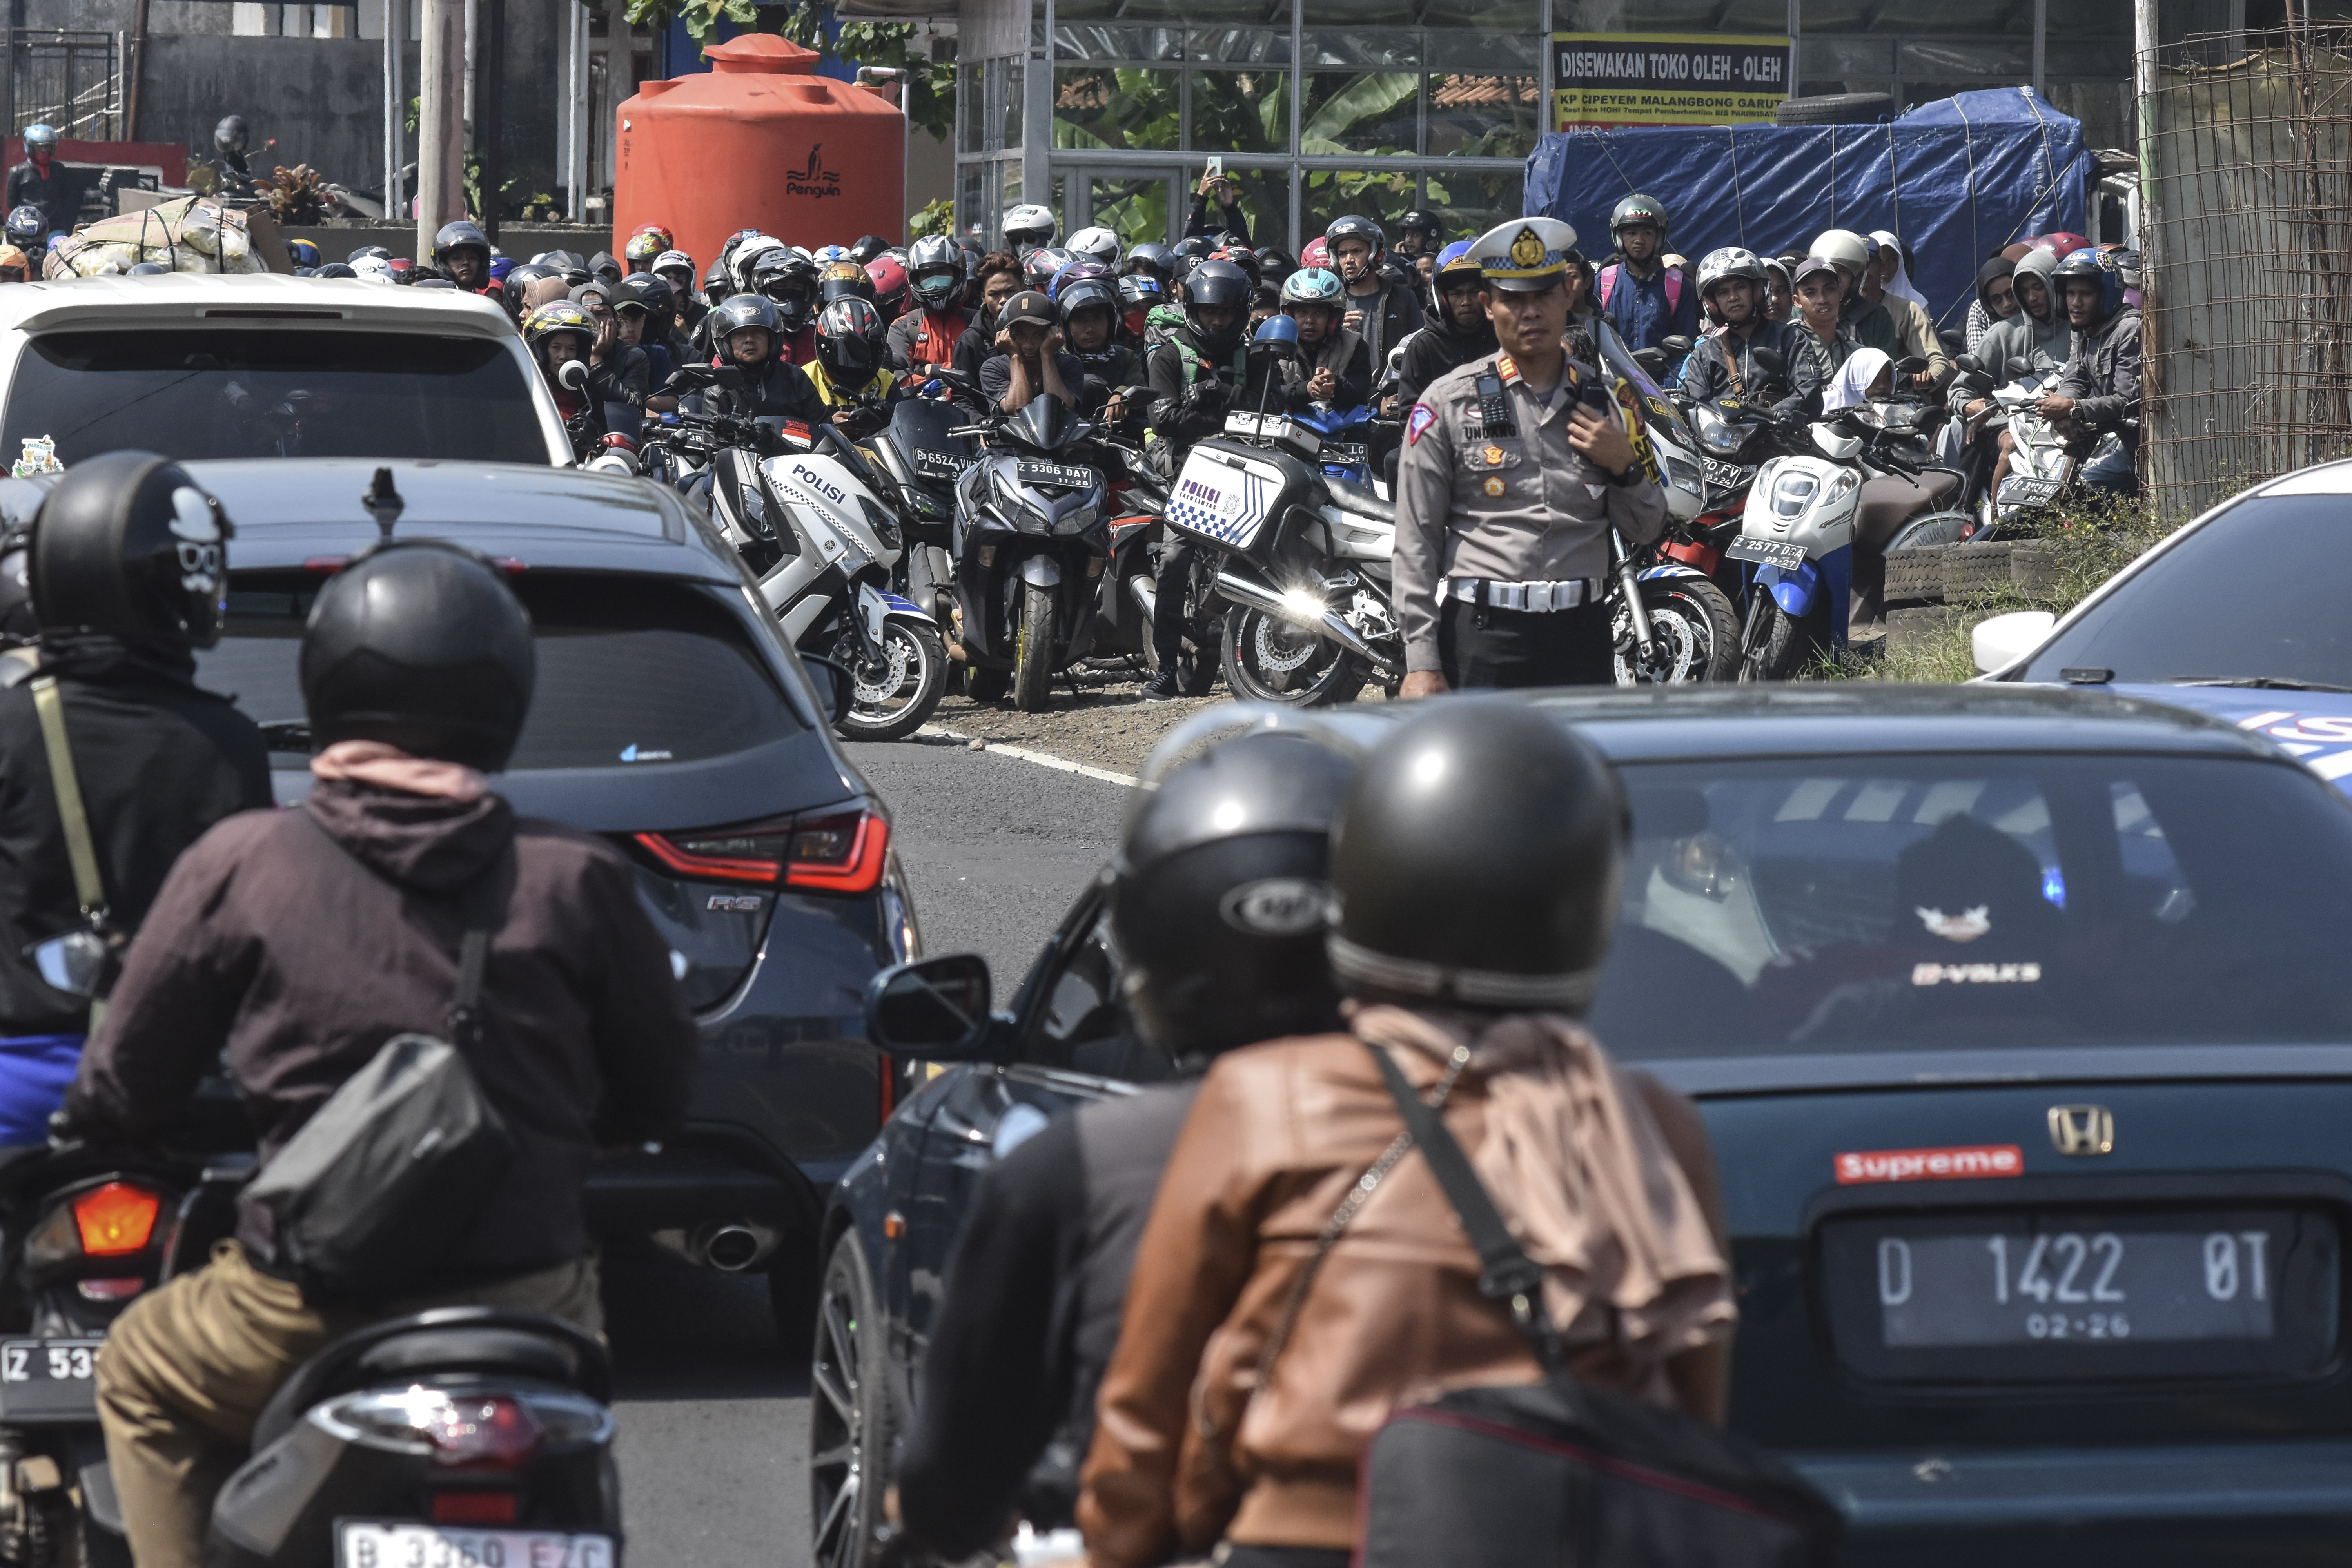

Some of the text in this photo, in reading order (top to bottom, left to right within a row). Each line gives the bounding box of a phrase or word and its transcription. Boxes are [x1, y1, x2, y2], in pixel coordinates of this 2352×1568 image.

[1561, 52, 1645, 78] DISEWAKAN
[1650, 53, 1688, 79] TOKO
[1693, 54, 1731, 81] OLEH
[1743, 56, 1781, 82] OLEH
[1560, 94, 1783, 109] KP CIPEYEM MALANGBONG GARUT
[786, 182, 840, 199] Penguin
[1295, 430, 1302, 439] 42
[1465, 424, 1517, 439] UNDANG
[1352, 445, 1364, 454] LG
[1031, 464, 1062, 475] 5306
[1066, 468, 1089, 478] DAY
[1720, 464, 1739, 477] FV
[792, 463, 846, 505] POLISI
[1181, 479, 1221, 504] POLISI
[1142, 498, 1161, 512] HONDA
[1179, 492, 1217, 510] LALU LINTAS
[1733, 537, 1744, 547] Z
[706, 894, 763, 911] RS
[1840, 1148, 2019, 1181] Supreme
[1877, 1236, 1912, 1306] D
[1986, 1230, 2126, 1305] 1422
[9, 1347, 100, 1381] Z 53
[356, 1535, 379, 1568] B
